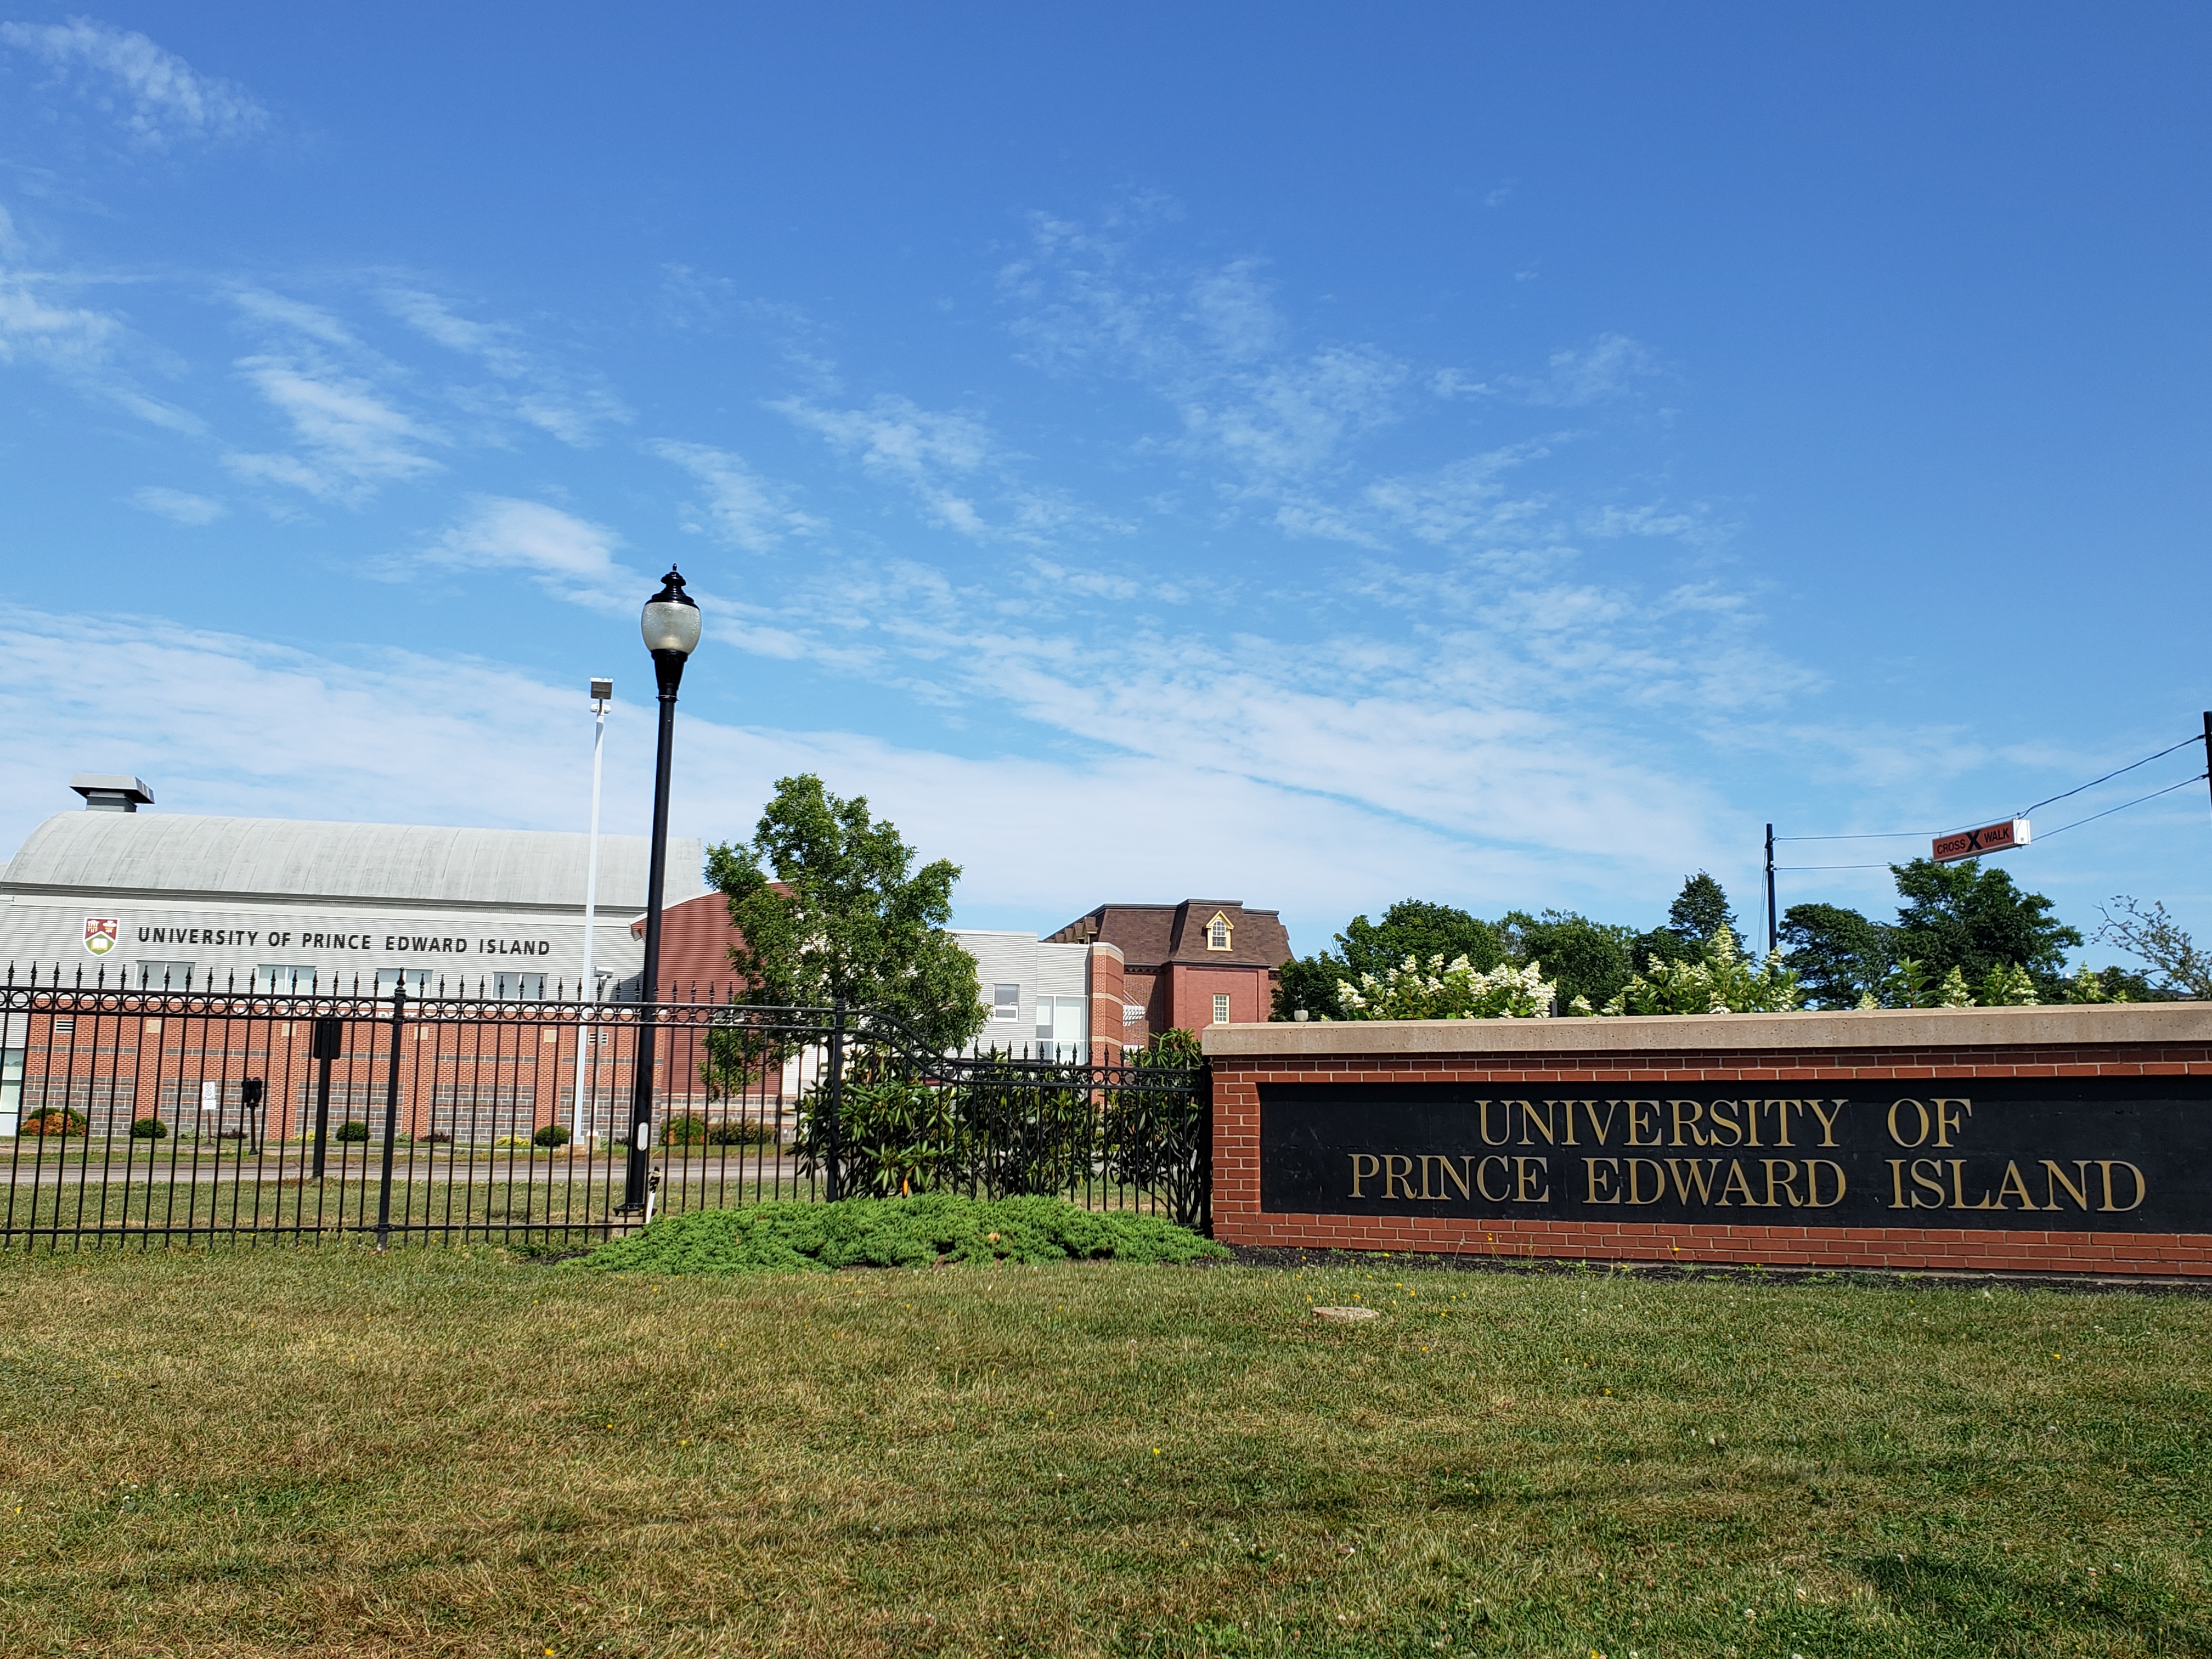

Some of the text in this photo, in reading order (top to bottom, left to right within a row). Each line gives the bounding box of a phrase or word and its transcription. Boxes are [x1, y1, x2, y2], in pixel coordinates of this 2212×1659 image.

[1937, 838, 1966, 855] CROSS
[1984, 827, 2010, 843] WALK
[138, 927, 550, 955] UNIVERSITY OF PRINCE EDWARD ISLAND
[1474, 1098, 1972, 1148] UNIVERSITY OF
[1347, 1153, 2146, 1212] PRINCE EDWARD ISLAND
